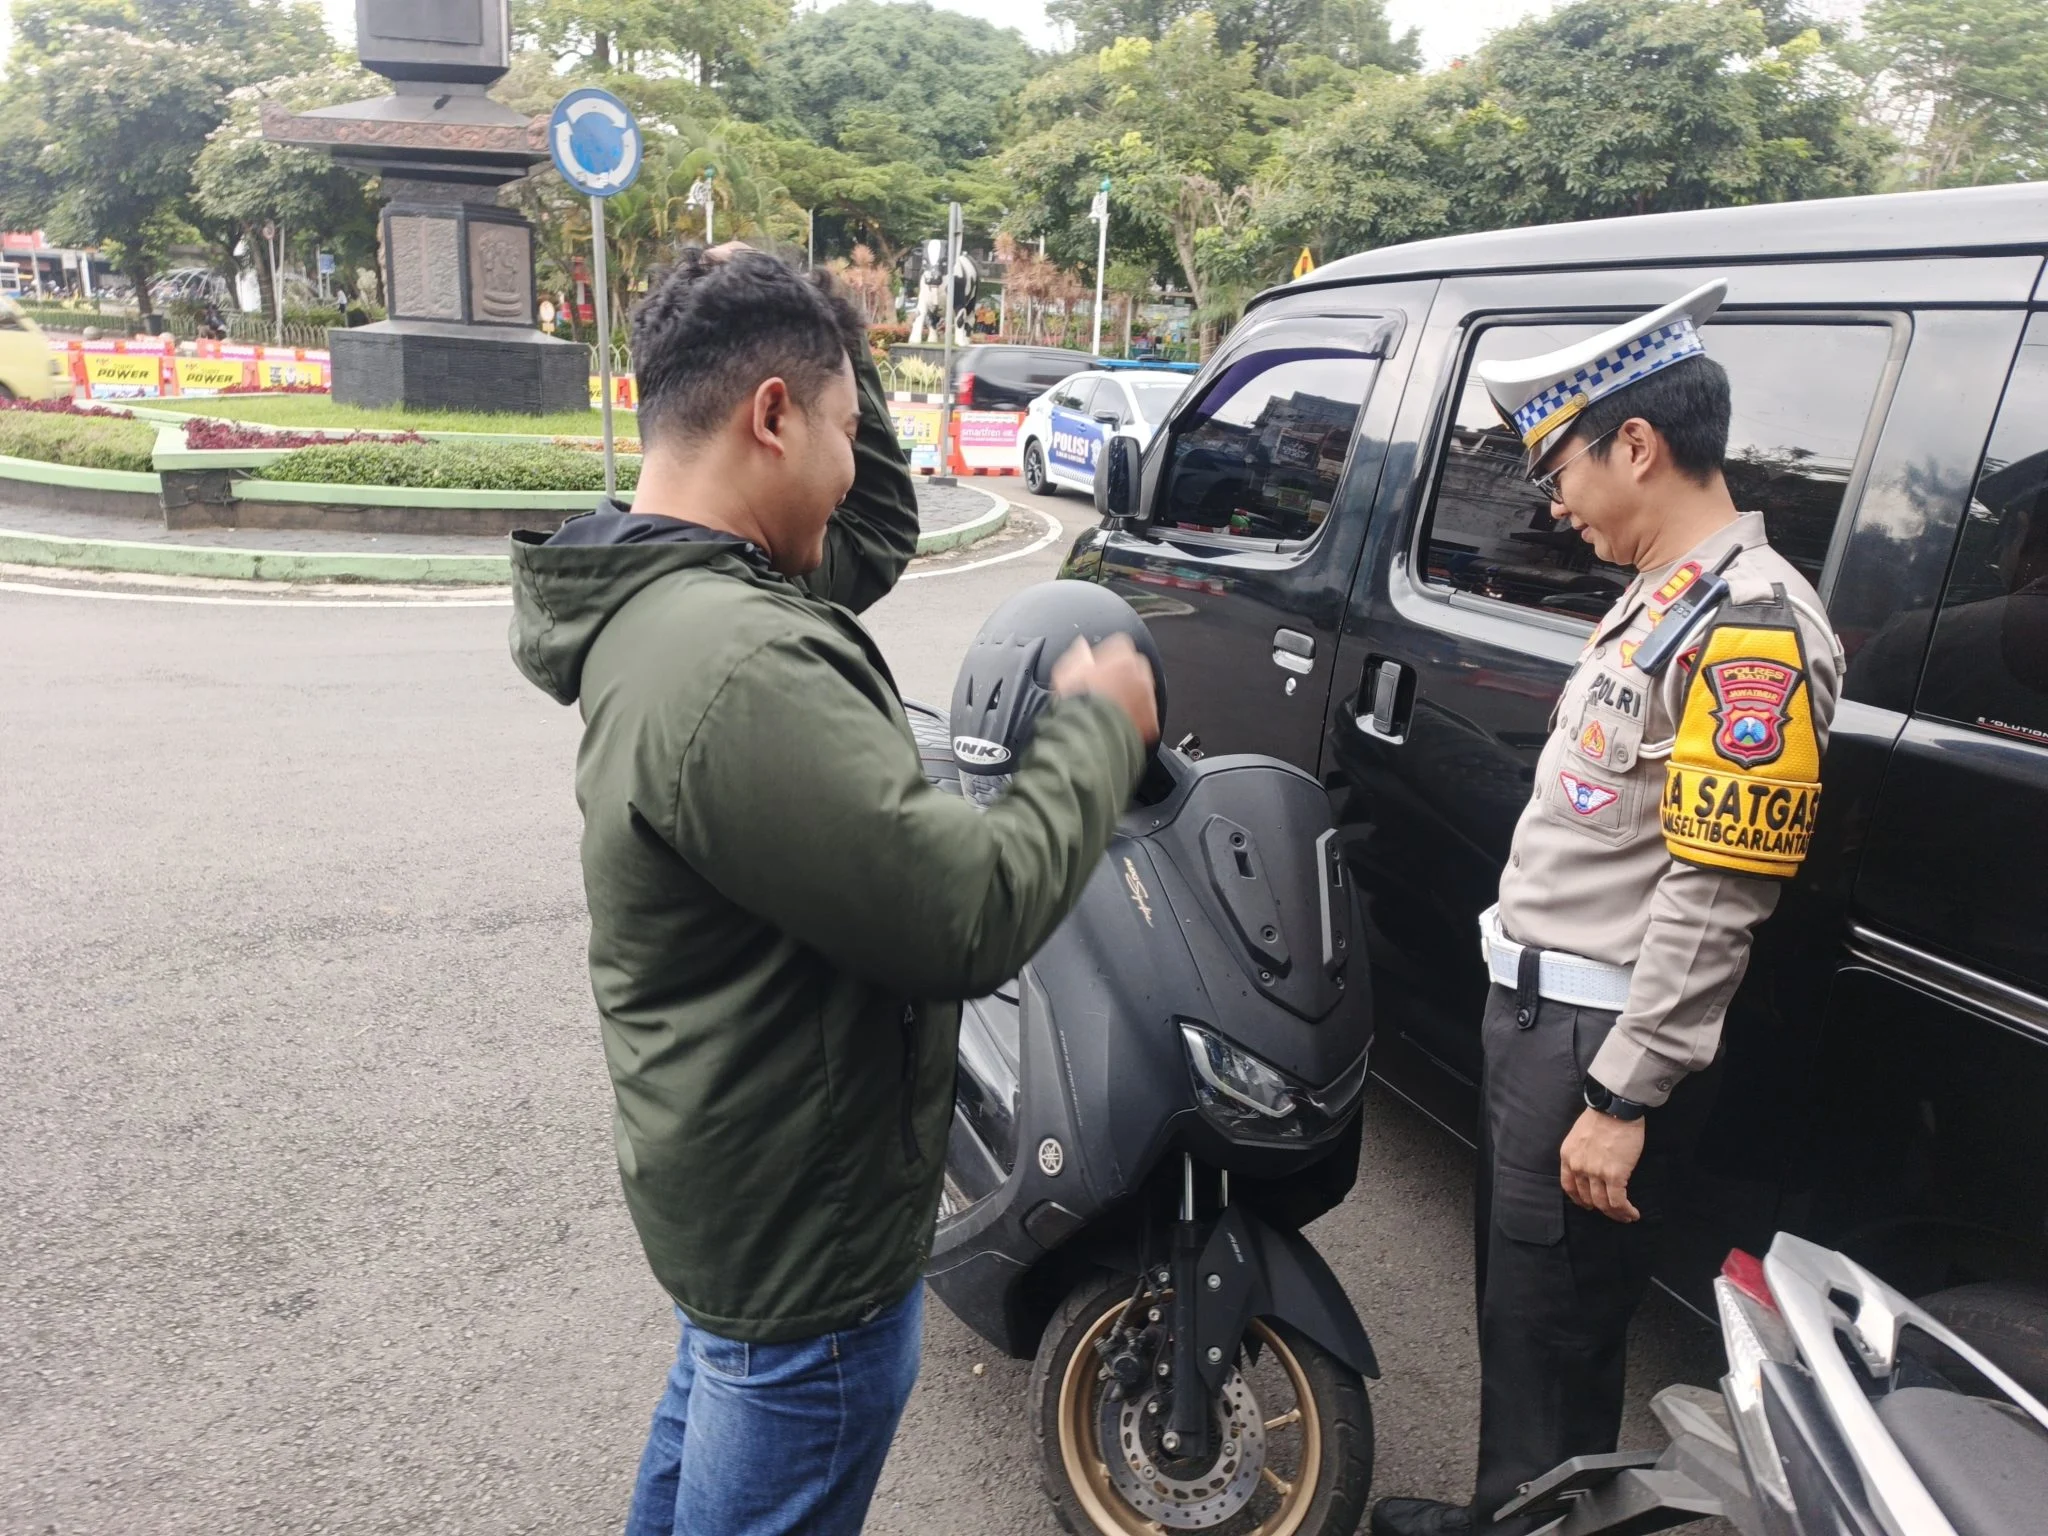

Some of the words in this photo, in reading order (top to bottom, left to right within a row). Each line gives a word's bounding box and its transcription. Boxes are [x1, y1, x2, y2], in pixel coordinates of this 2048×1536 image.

[97, 368, 150, 379] POWER
[186, 373, 234, 384] POWER
[1053, 431, 1089, 458] POLISI
[1723, 666, 1785, 680] POLRES
[1588, 672, 1641, 718] POLRI
[956, 740, 1000, 758] INK
[1694, 775, 1820, 832] SATGAS
